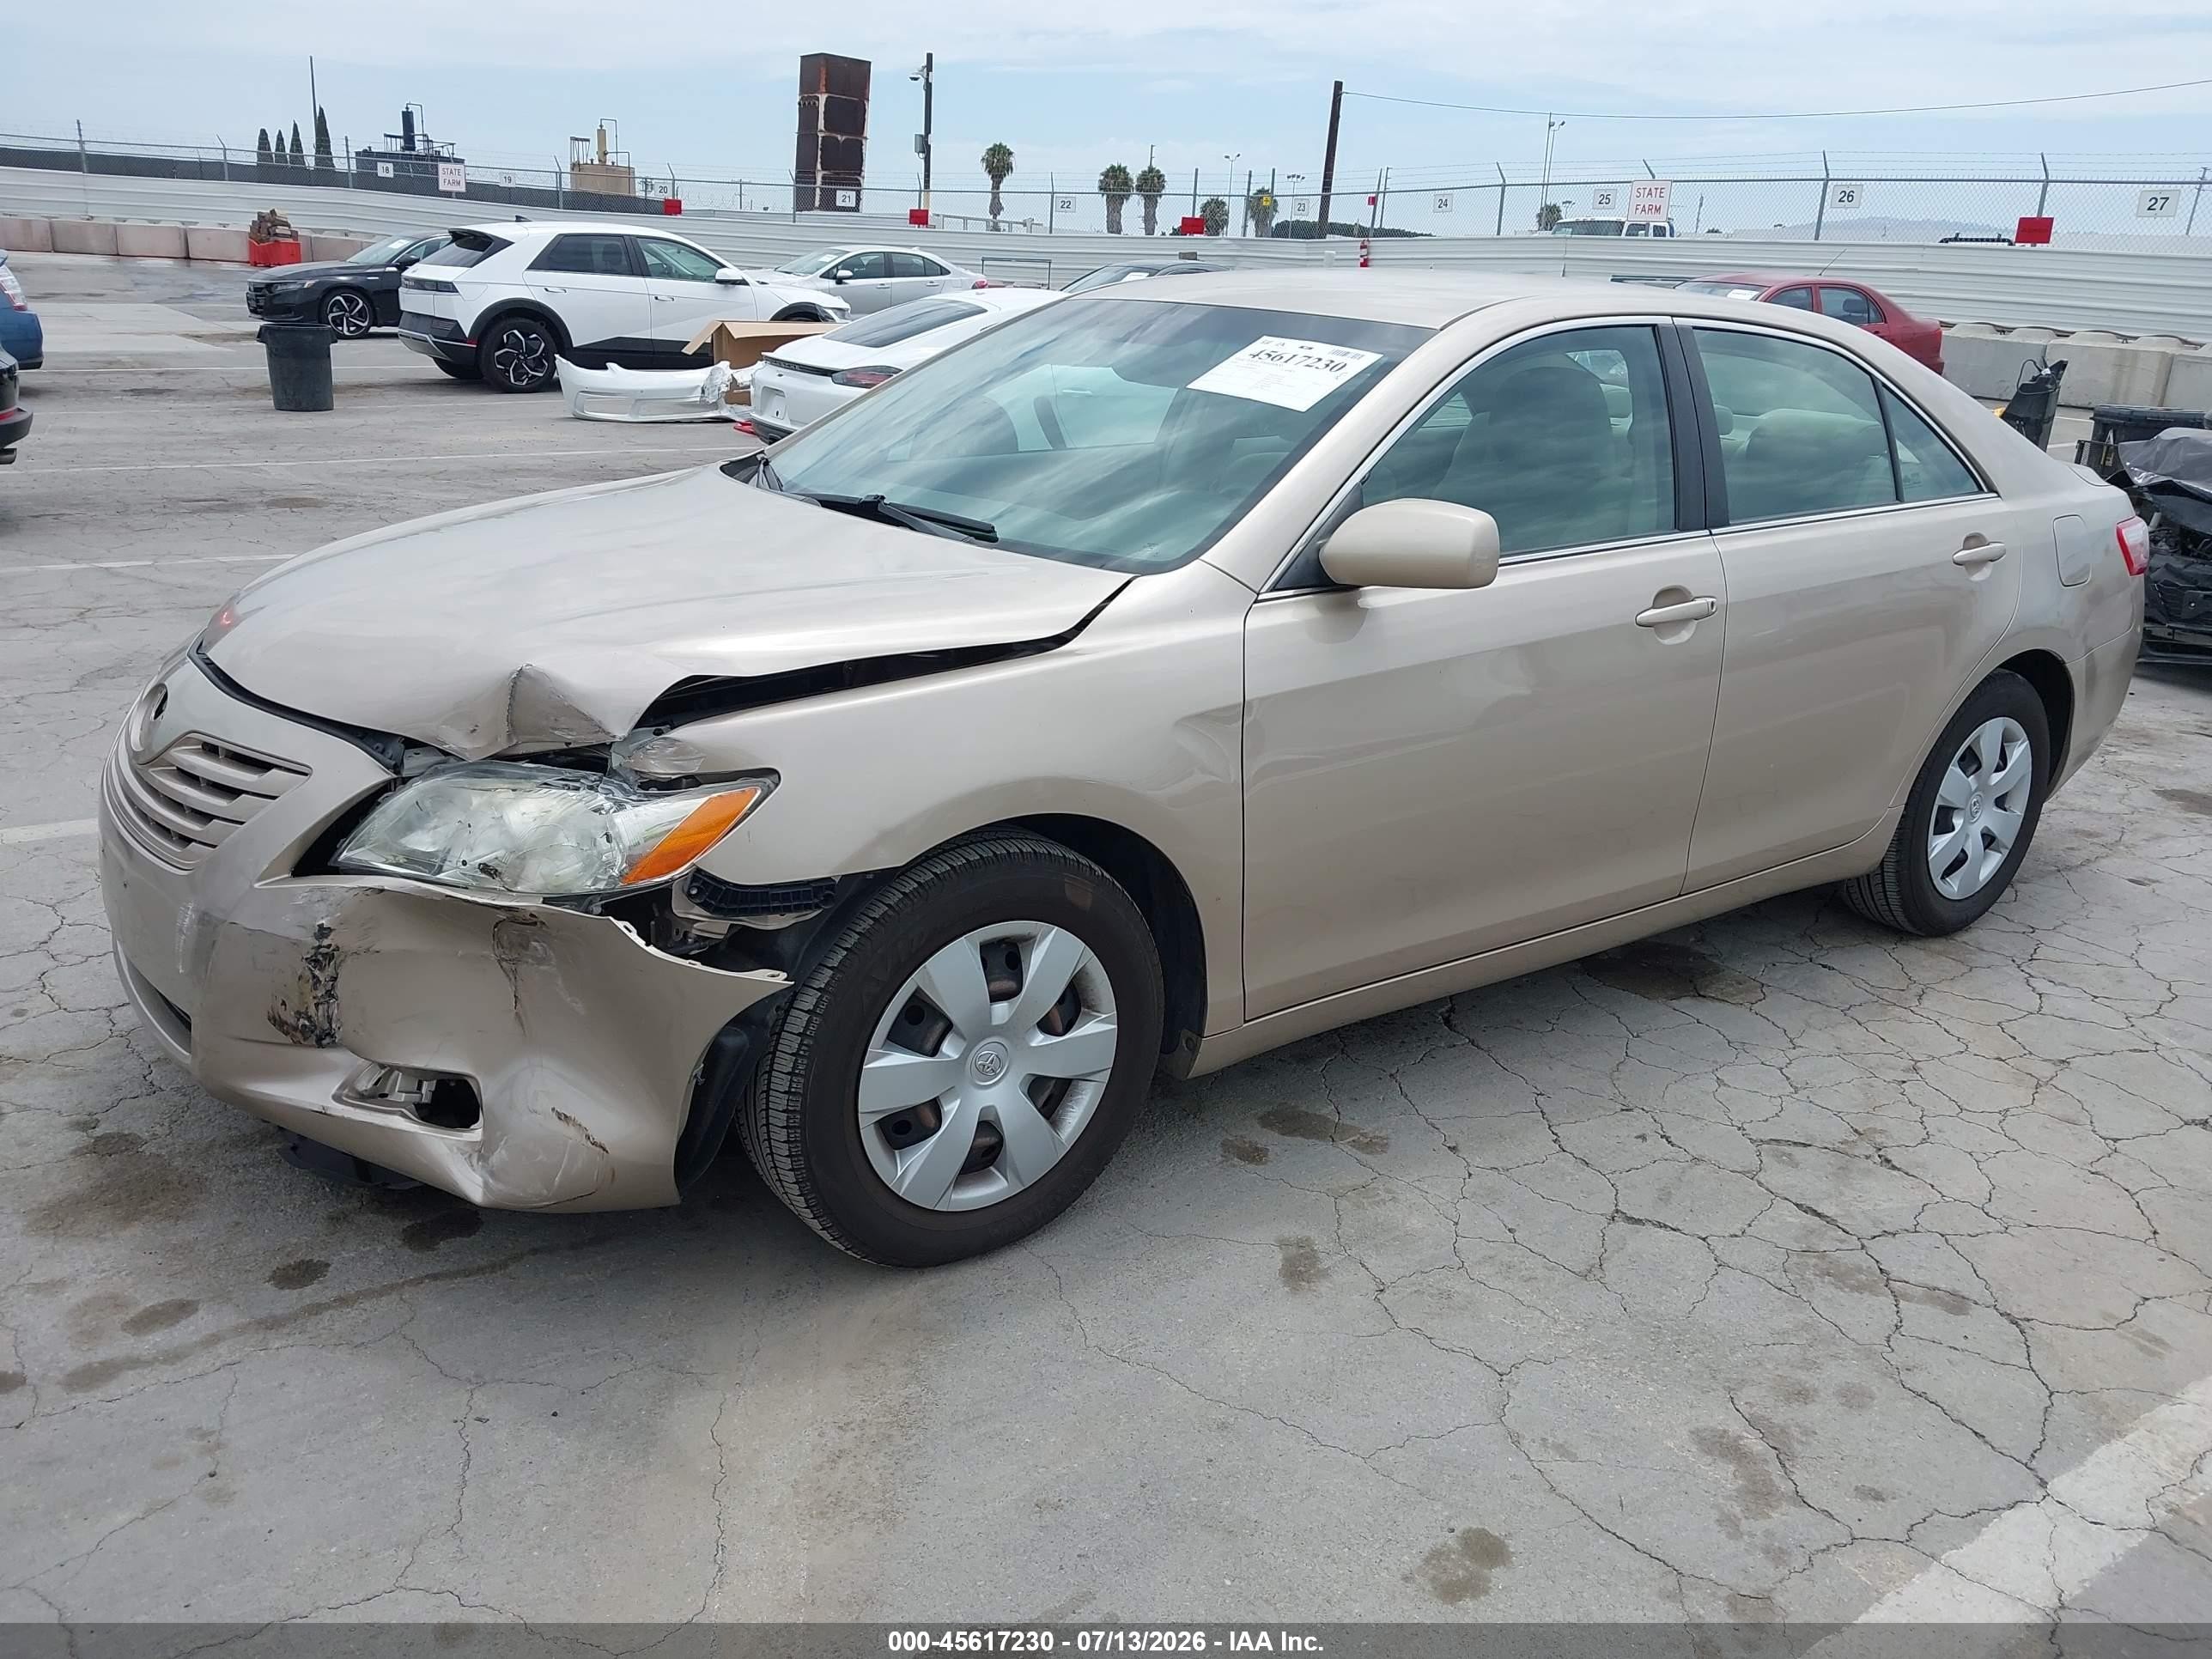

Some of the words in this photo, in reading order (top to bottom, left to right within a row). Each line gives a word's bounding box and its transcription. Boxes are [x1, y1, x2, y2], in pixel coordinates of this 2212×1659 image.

[382, 166, 390, 174] 18
[442, 167, 461, 177] STATE
[443, 179, 461, 187] FARM
[659, 185, 668, 194] 20
[1636, 187, 1665, 198] STATE
[842, 194, 851, 203] 21
[1598, 194, 1611, 205] 25
[1838, 190, 1855, 203] 26
[1060, 200, 1072, 209] 22
[1297, 203, 1305, 211] 23
[1438, 198, 1448, 208] 24
[2147, 197, 2170, 210] 27
[1635, 204, 1662, 215] FARM
[1249, 349, 1347, 373] 45617230
